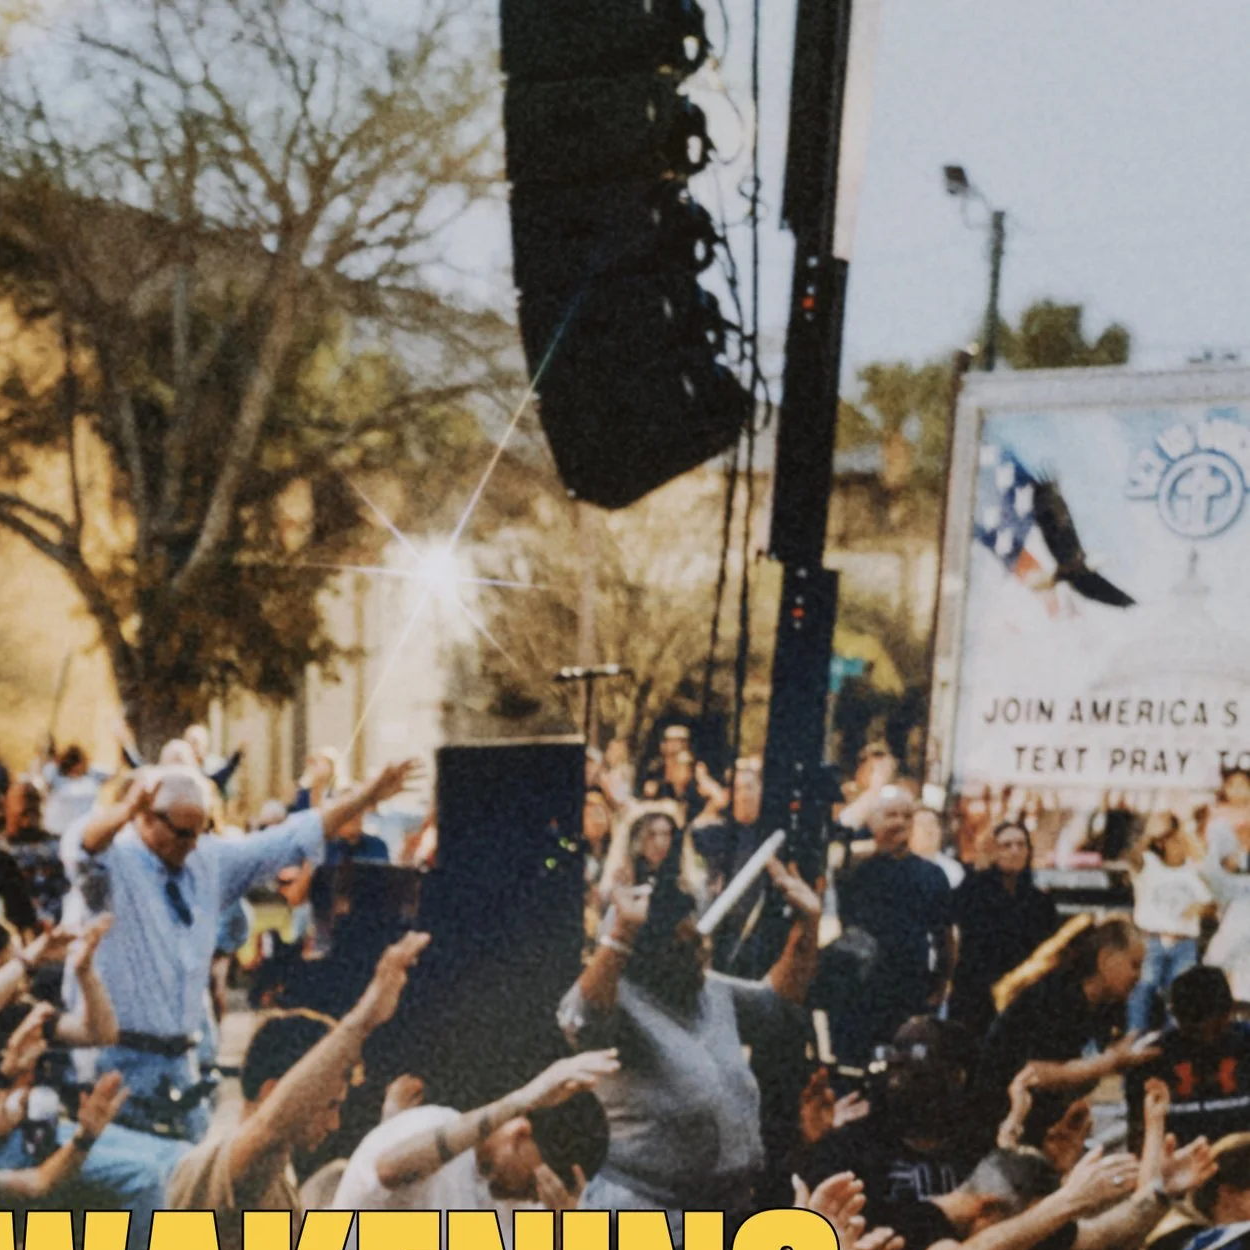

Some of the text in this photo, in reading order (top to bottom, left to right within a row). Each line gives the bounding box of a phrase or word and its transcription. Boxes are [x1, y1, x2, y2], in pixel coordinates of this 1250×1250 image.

[983, 698, 1055, 724] JOIN
[1013, 746, 1089, 772] TEXT
[1108, 747, 1191, 775] PRAY
